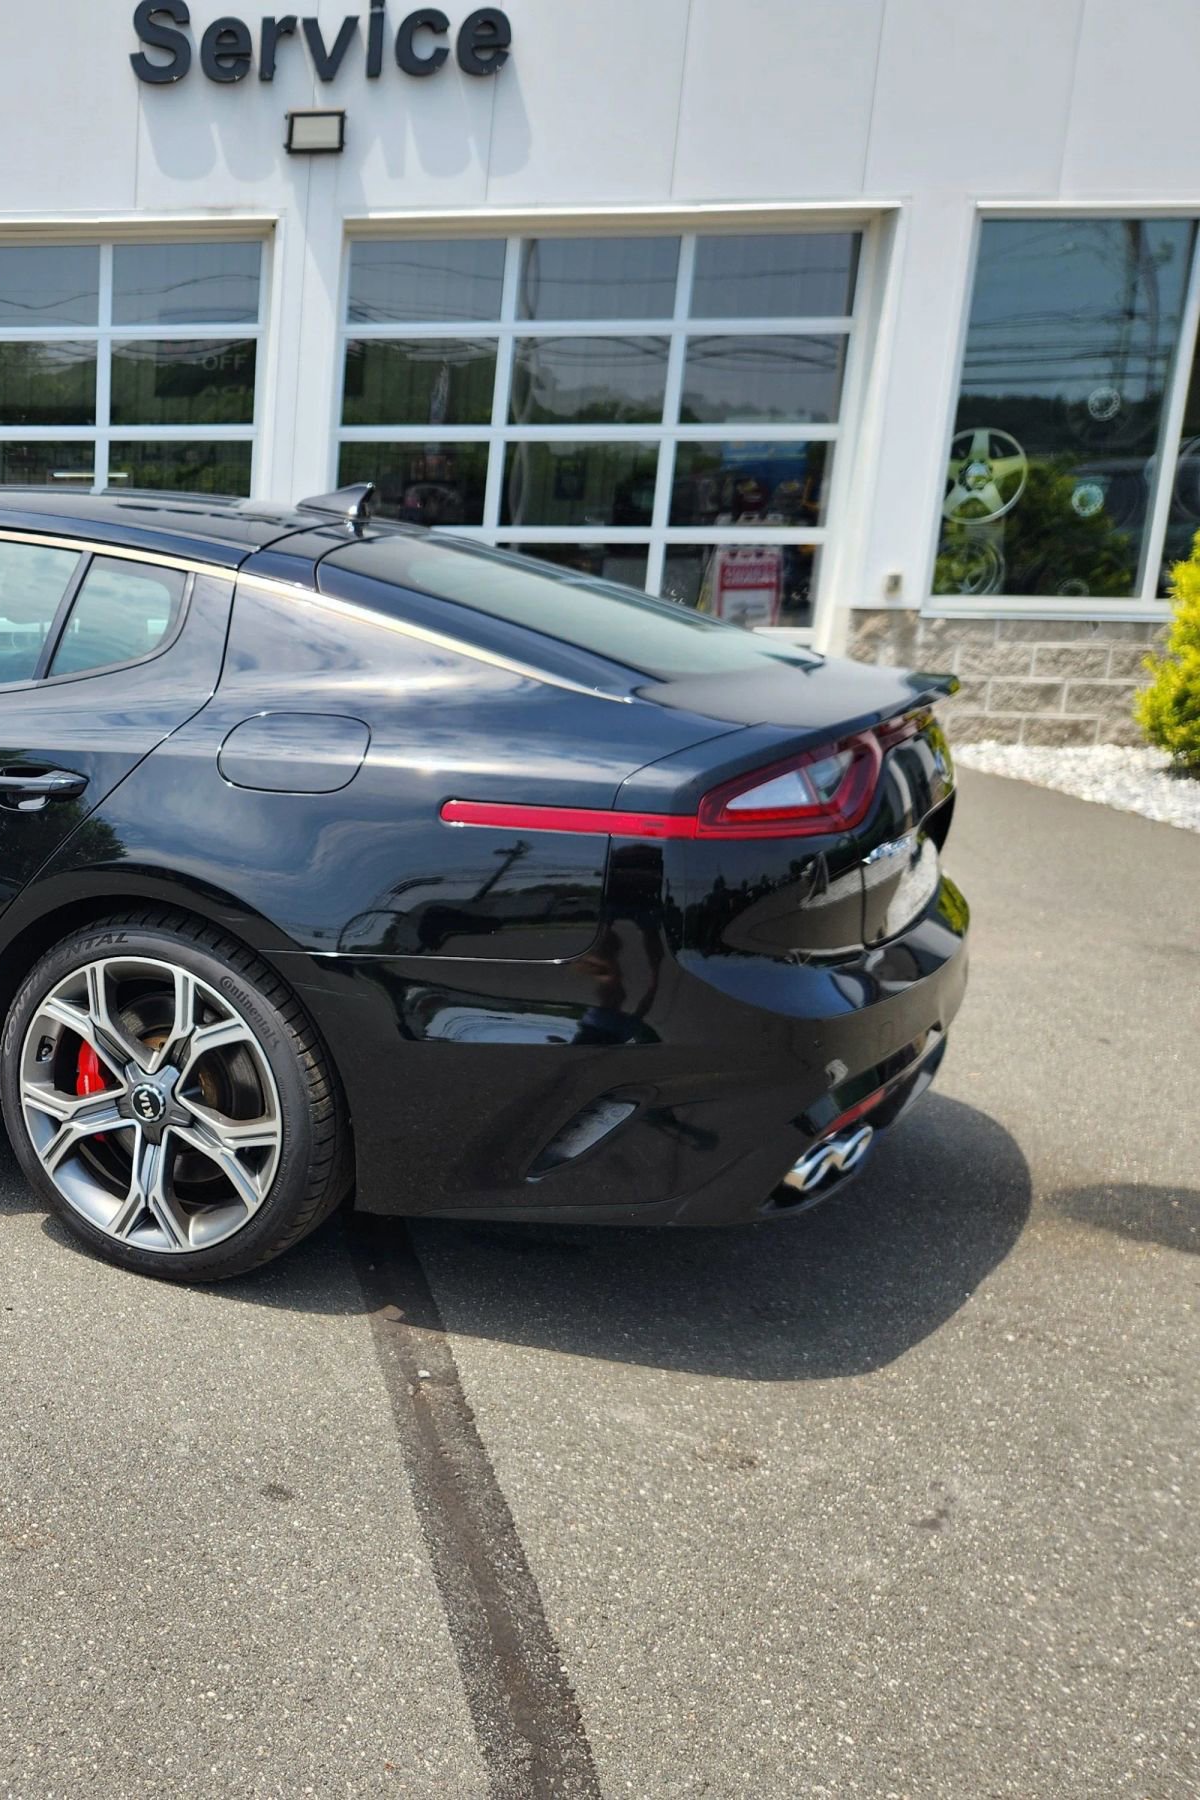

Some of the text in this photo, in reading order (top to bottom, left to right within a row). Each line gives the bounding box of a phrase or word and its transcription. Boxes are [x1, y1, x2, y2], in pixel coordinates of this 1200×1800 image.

[129, 0, 512, 84] Service
[220, 975, 276, 1039] Continental
[138, 1090, 155, 1118] KIA
